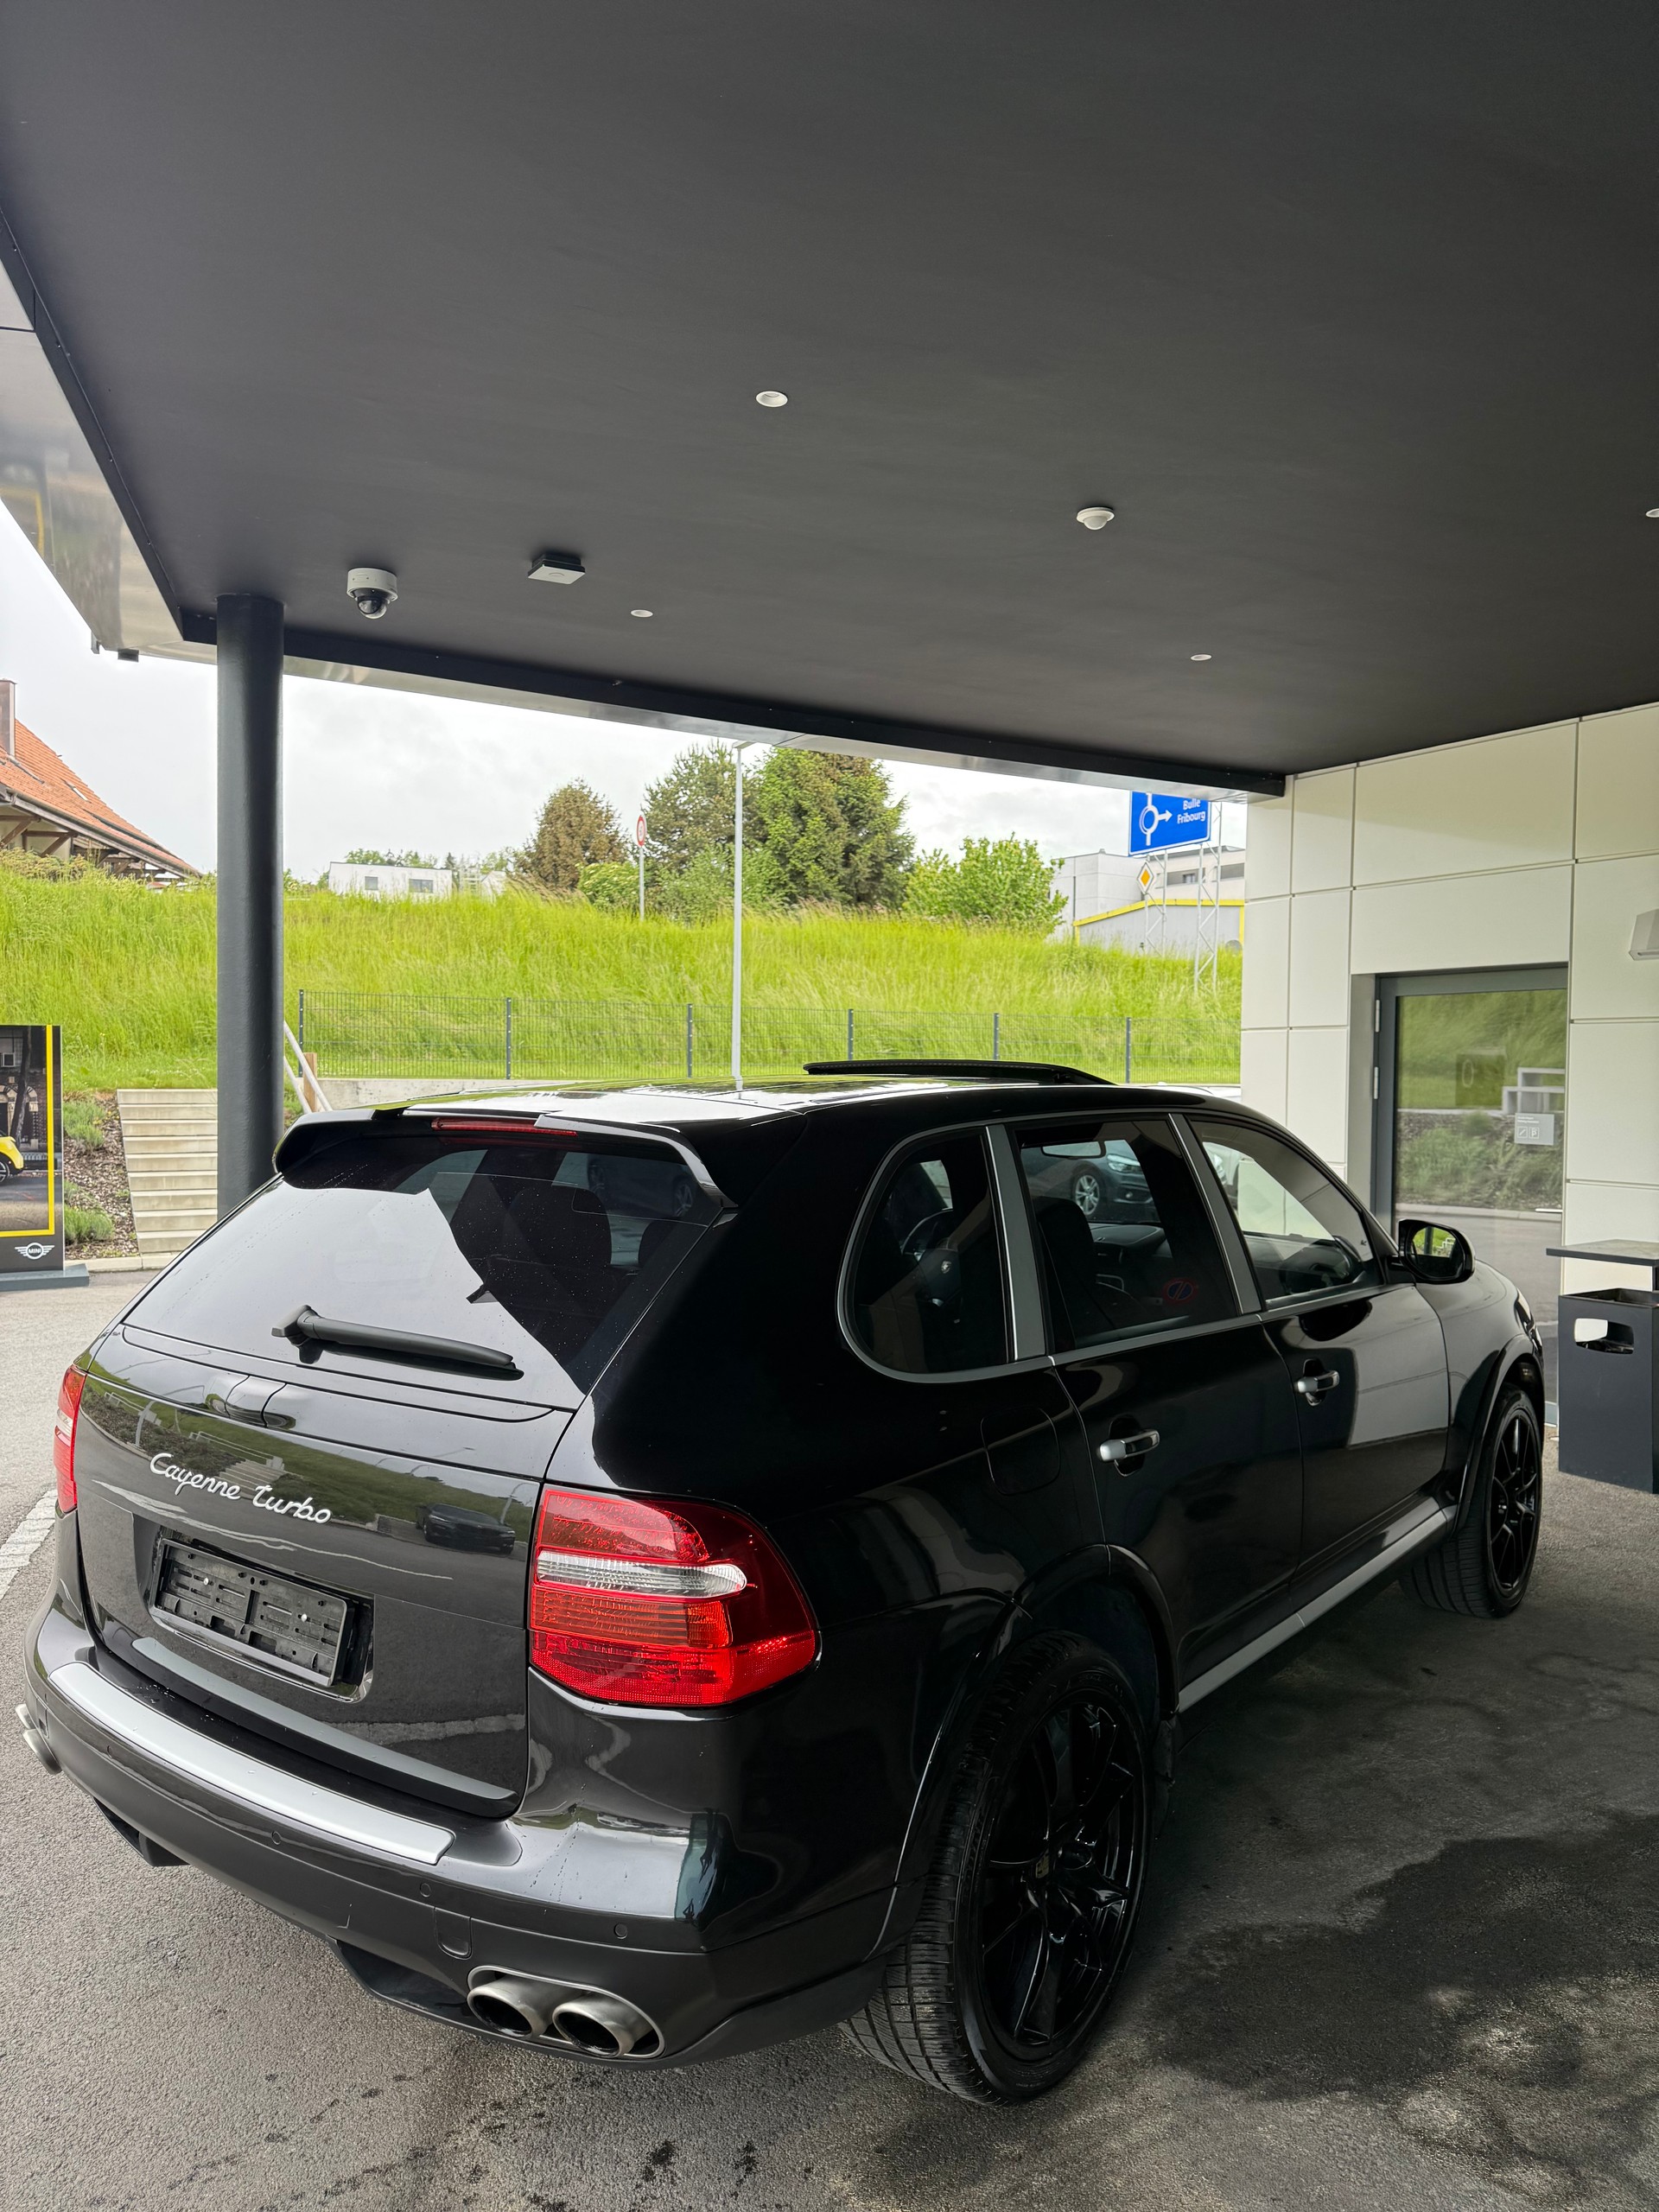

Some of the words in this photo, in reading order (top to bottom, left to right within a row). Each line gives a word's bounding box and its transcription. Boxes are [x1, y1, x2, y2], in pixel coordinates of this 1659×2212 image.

[1183, 798, 1201, 810] Bulle
[1177, 811, 1206, 824] Fribourg
[149, 1452, 241, 1496] Cayenne
